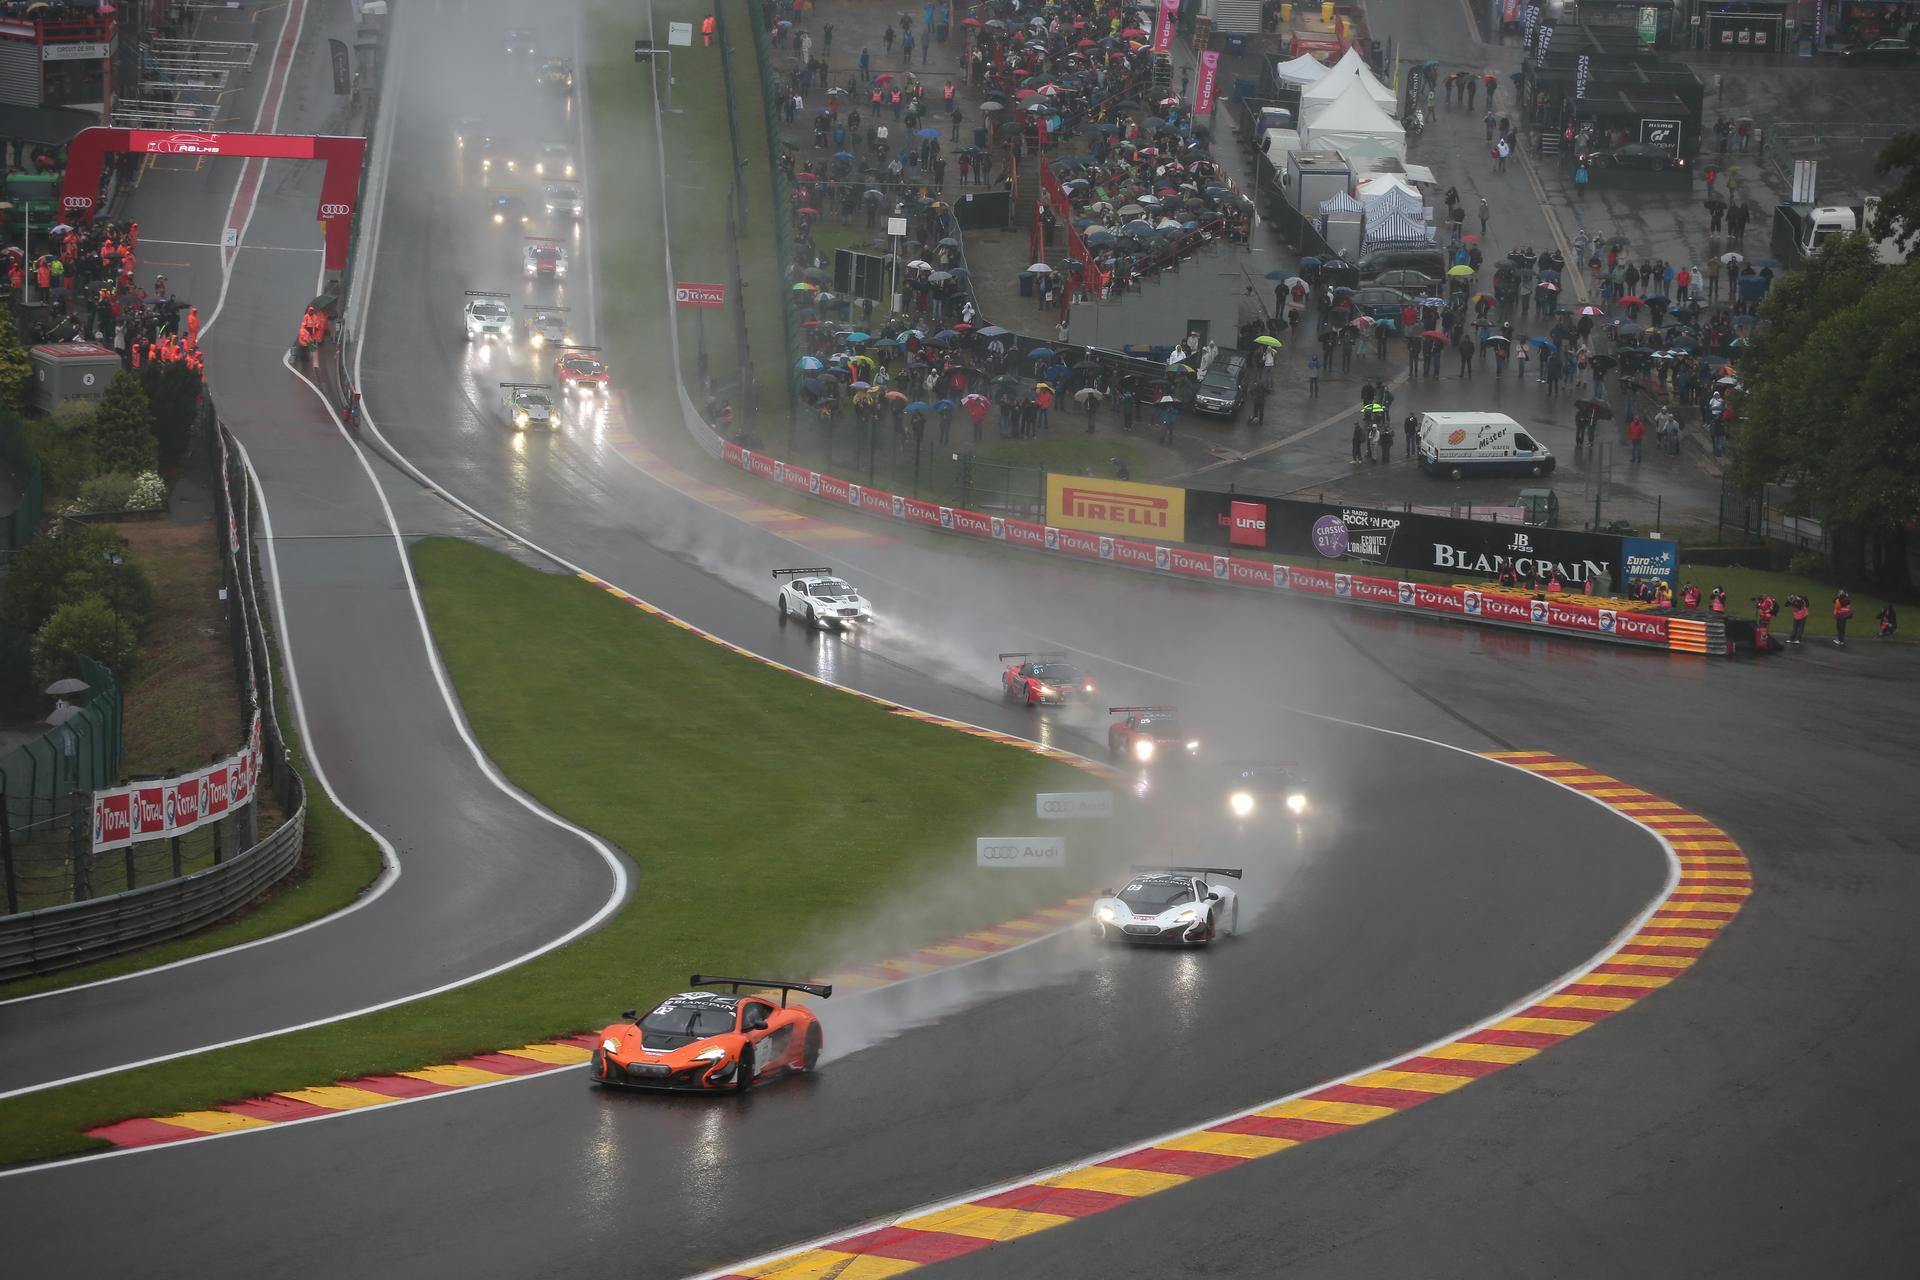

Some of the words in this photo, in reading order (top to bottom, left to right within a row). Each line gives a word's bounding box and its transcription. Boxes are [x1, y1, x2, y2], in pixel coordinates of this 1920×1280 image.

[1203, 70, 1214, 97] deux
[1576, 55, 1585, 99] NISSAN
[1201, 100, 1209, 109] la
[689, 291, 723, 301] TOTAL
[1479, 427, 1507, 449] Mister
[783, 468, 809, 487] TOTAL
[820, 479, 848, 499] TOTAL
[860, 491, 892, 510] TOTAL
[1062, 487, 1169, 528] PIRELLI
[905, 503, 939, 521] TOTAL
[1351, 509, 1368, 517] RADIO
[954, 514, 991, 532] TOTAL
[1218, 513, 1231, 526] la
[1235, 518, 1266, 530] une
[1317, 525, 1345, 536] CLASSIC
[1342, 514, 1369, 526] ROCK
[1381, 518, 1401, 529] POP
[1006, 524, 1044, 543] TOTAL
[1318, 537, 1330, 547] 21
[1361, 535, 1387, 546] ECOUTEZ
[1060, 534, 1098, 552] TOTAL
[1507, 544, 1534, 553] 1735
[1114, 543, 1154, 562] TOTAL
[1626, 556, 1651, 566] Euro
[1171, 553, 1212, 572] TOTAL
[1630, 565, 1671, 576] Millions
[1230, 563, 1272, 581] TOTAL
[1291, 572, 1333, 589] TOTAL
[1353, 580, 1396, 598] TOTAL
[1416, 589, 1462, 607] TOTAL
[1482, 598, 1529, 618] TOTAL
[1550, 607, 1597, 627] TOTAL
[1617, 616, 1665, 637] TOTAL
[141, 800, 163, 821] TOTAL
[1079, 801, 1111, 810] Audi
[104, 807, 130, 831] TOTAL
[1023, 847, 1059, 857] Audi
[1142, 879, 1191, 887] BLANCPAIN
[653, 1006, 675, 1015] 02
[674, 1000, 735, 1011] BLANCPAIN
